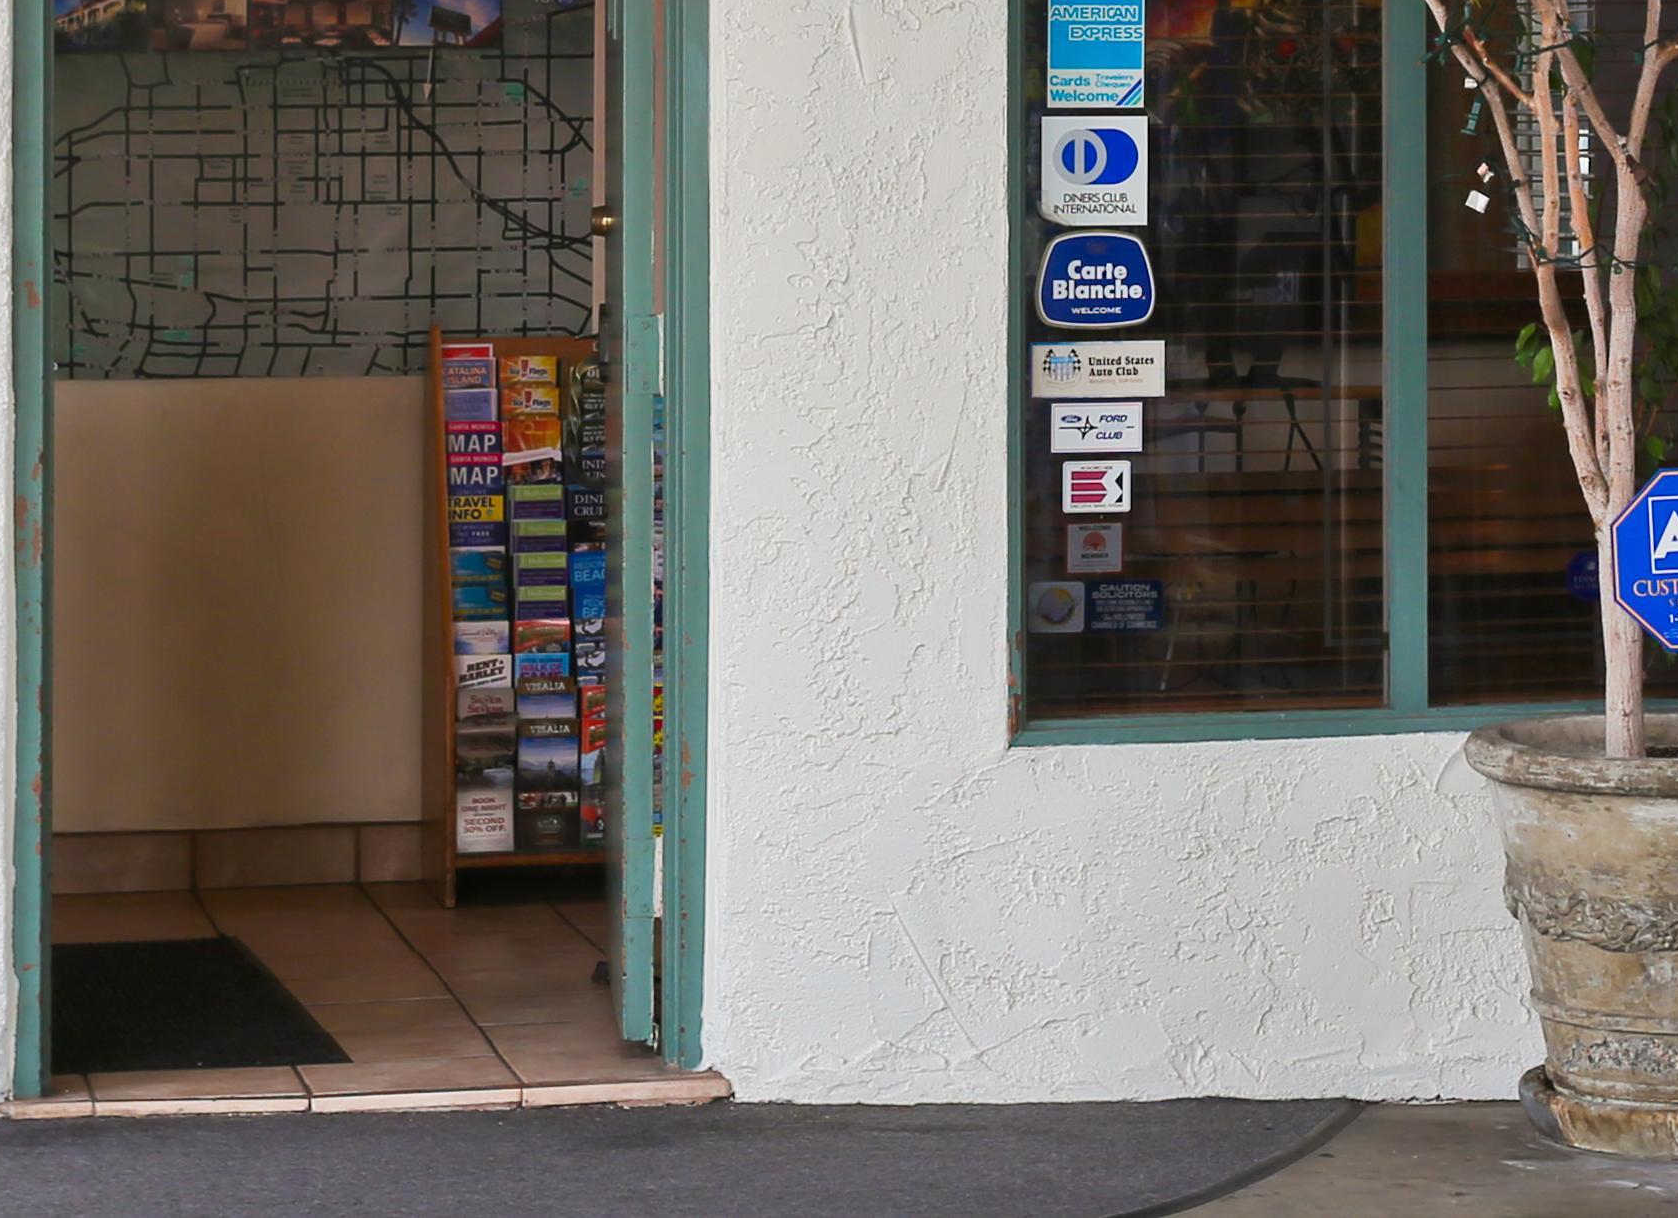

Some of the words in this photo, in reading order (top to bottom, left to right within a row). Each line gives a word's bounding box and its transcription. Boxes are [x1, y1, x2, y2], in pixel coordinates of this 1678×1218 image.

[1050, 5, 1138, 22] AMERICAN
[1069, 25, 1143, 41] EXPRESS
[1049, 75, 1091, 87] Cards
[1049, 89, 1119, 102] Welcome
[1063, 193, 1100, 204] DINERS
[1102, 193, 1128, 203] CLUB
[1053, 204, 1137, 215] INTERNATIONAL
[1067, 259, 1128, 280] Carte
[1088, 356, 1122, 366] United
[1124, 356, 1155, 366] States
[1088, 368, 1113, 377] Auto
[1115, 367, 1139, 376] Club
[1099, 414, 1128, 423] FORD
[1095, 431, 1123, 440] CLUB
[448, 434, 496, 453] MAP
[450, 466, 499, 486] MAP
[448, 497, 495, 508] TRAVEL
[448, 509, 482, 520] INFO
[1091, 591, 1158, 599] SOLICITORS
[467, 658, 498, 672] RENT
[459, 666, 505, 683] HARLEY
[525, 682, 566, 691] VISALIA
[530, 724, 571, 734] VISALIA
[464, 817, 505, 825] SECOND
